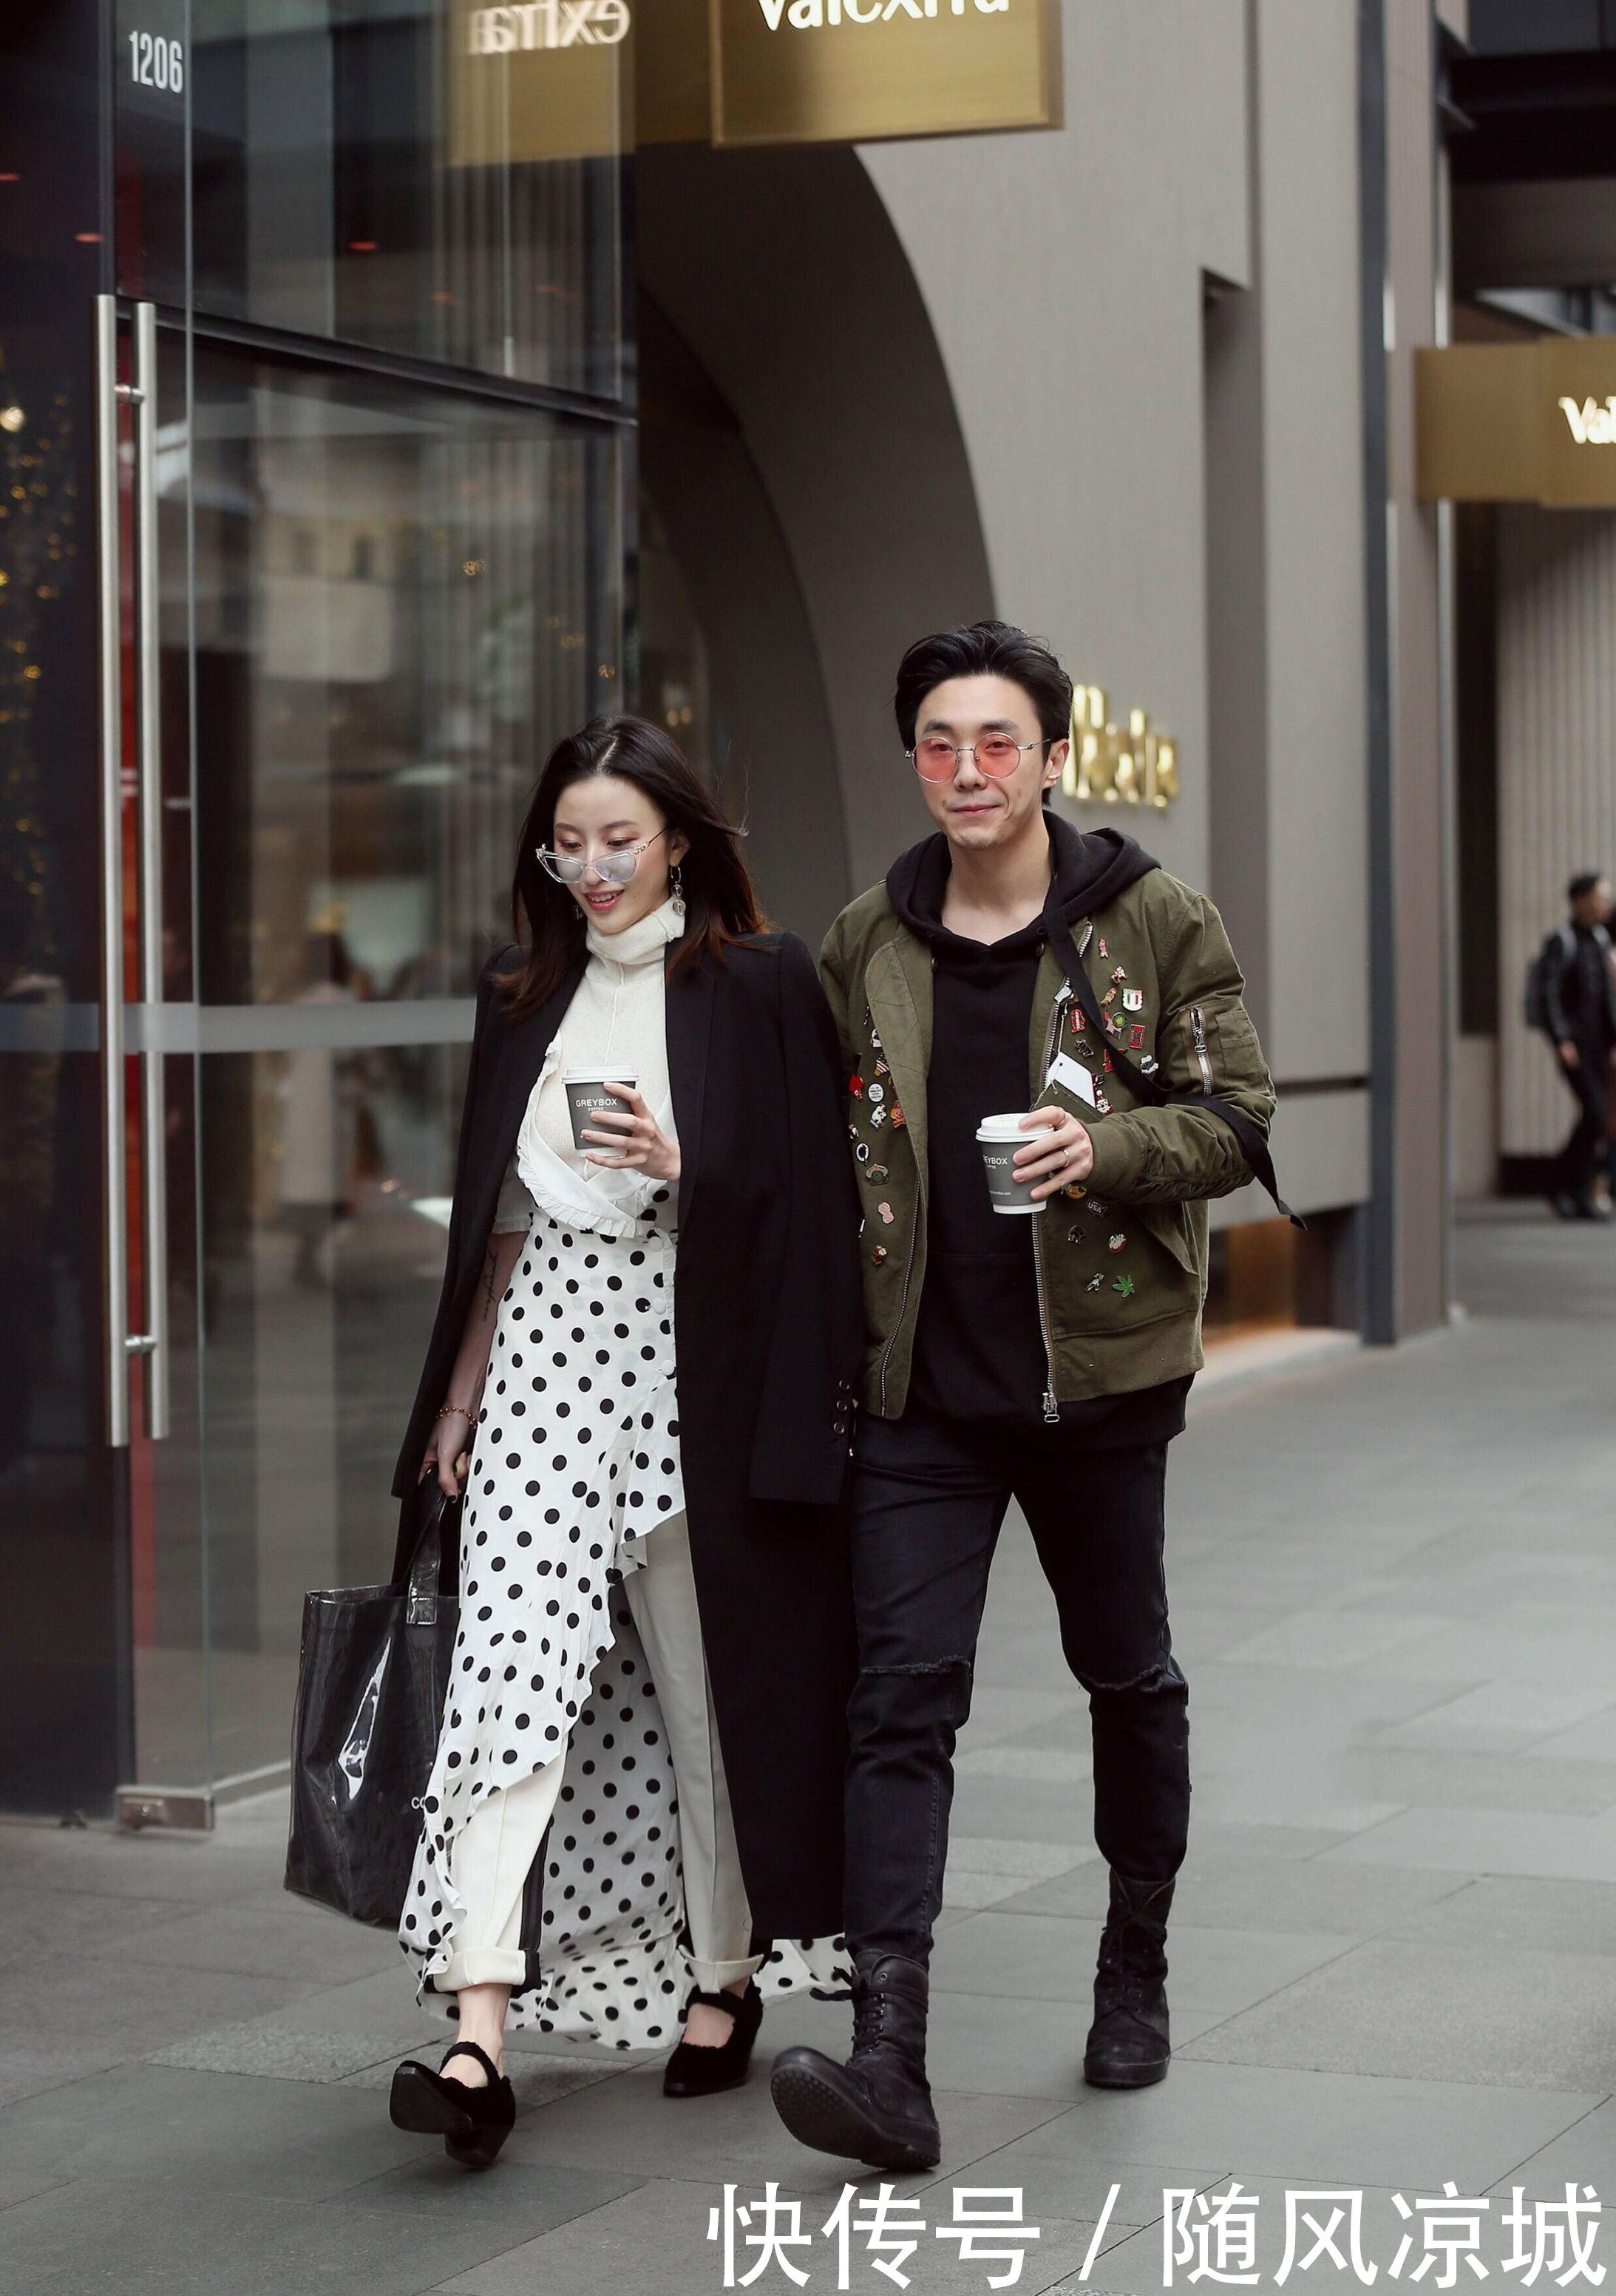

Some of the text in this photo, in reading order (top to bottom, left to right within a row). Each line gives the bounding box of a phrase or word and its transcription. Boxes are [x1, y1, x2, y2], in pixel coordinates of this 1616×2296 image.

[129, 30, 183, 94] 1206
[575, 1098, 617, 1107] GREYBOX
[1087, 1201, 1101, 1214] USA
